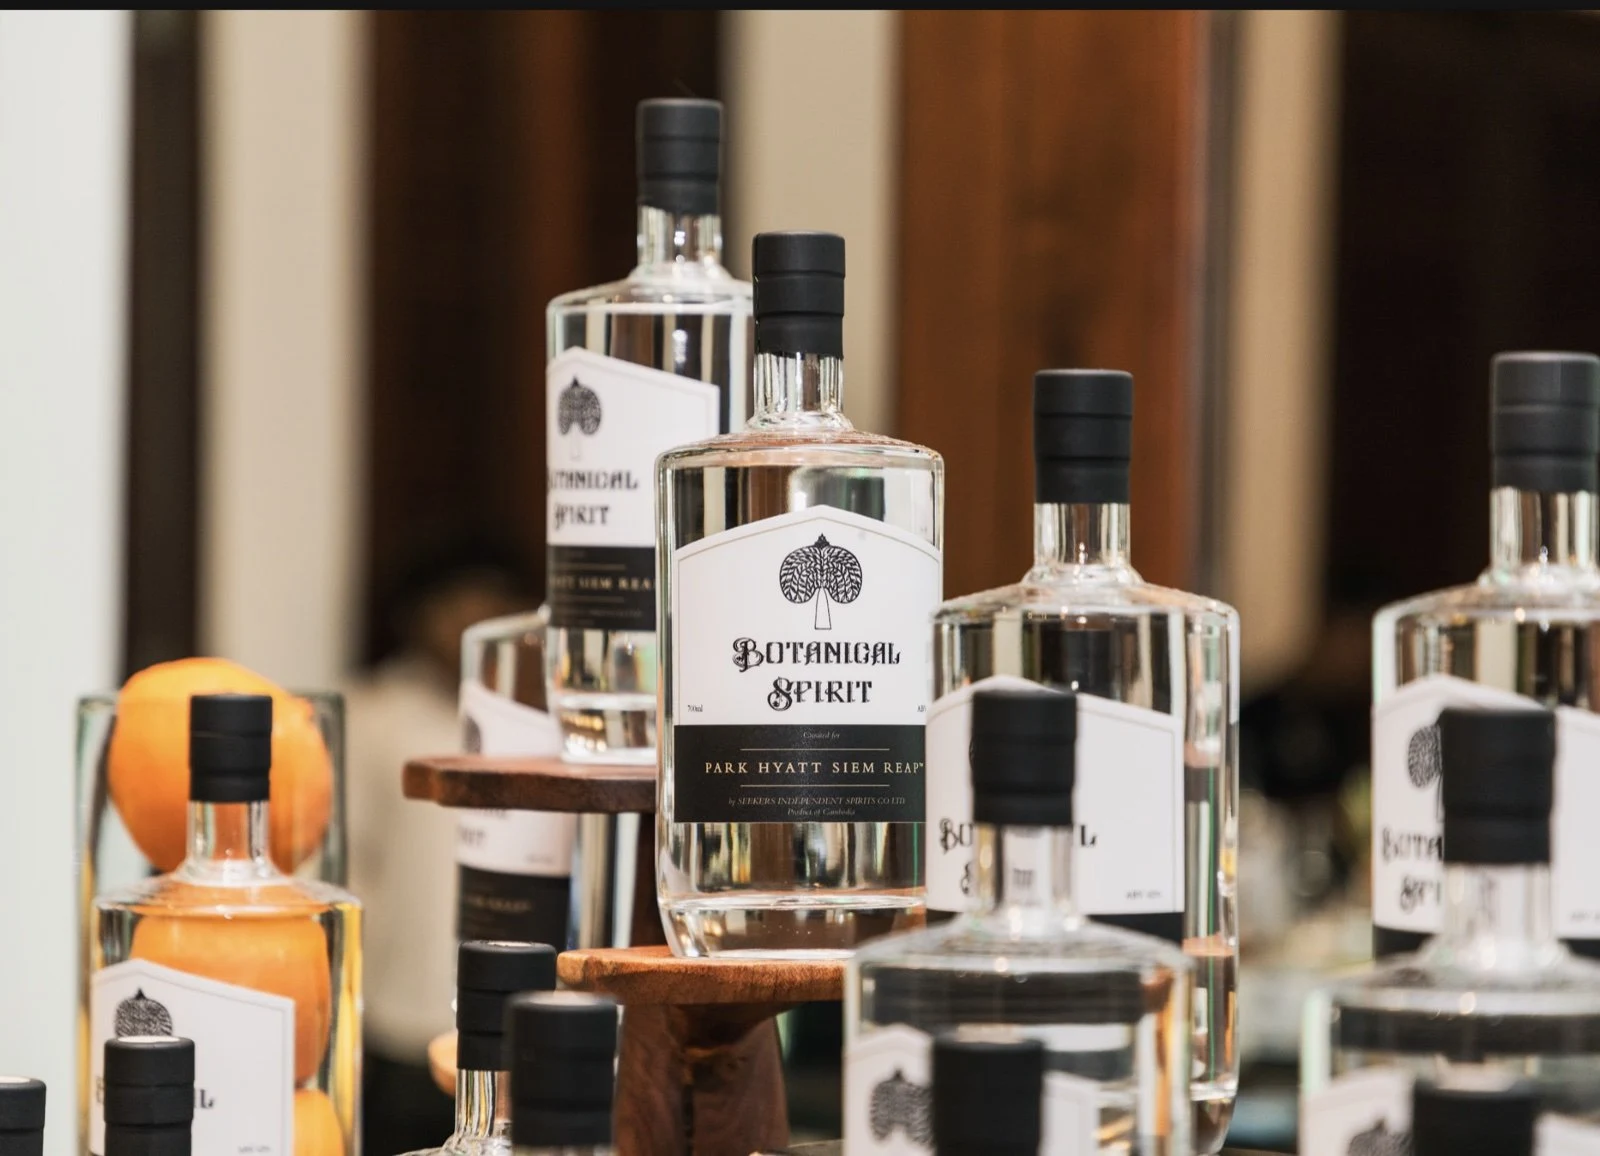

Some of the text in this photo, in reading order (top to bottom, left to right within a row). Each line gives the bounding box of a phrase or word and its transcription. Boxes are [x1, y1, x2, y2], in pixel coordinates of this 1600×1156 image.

[618, 577, 656, 590] REA
[732, 637, 901, 673] BOTANICAL
[767, 676, 873, 712] SPIRIT
[705, 762, 748, 774] PARK
[758, 762, 822, 774] HYATT
[832, 762, 875, 774] SIEM
[737, 797, 776, 805] SEEKERS
[777, 797, 843, 805] INDEPENDENT
[845, 797, 876, 805] SPIRITS
